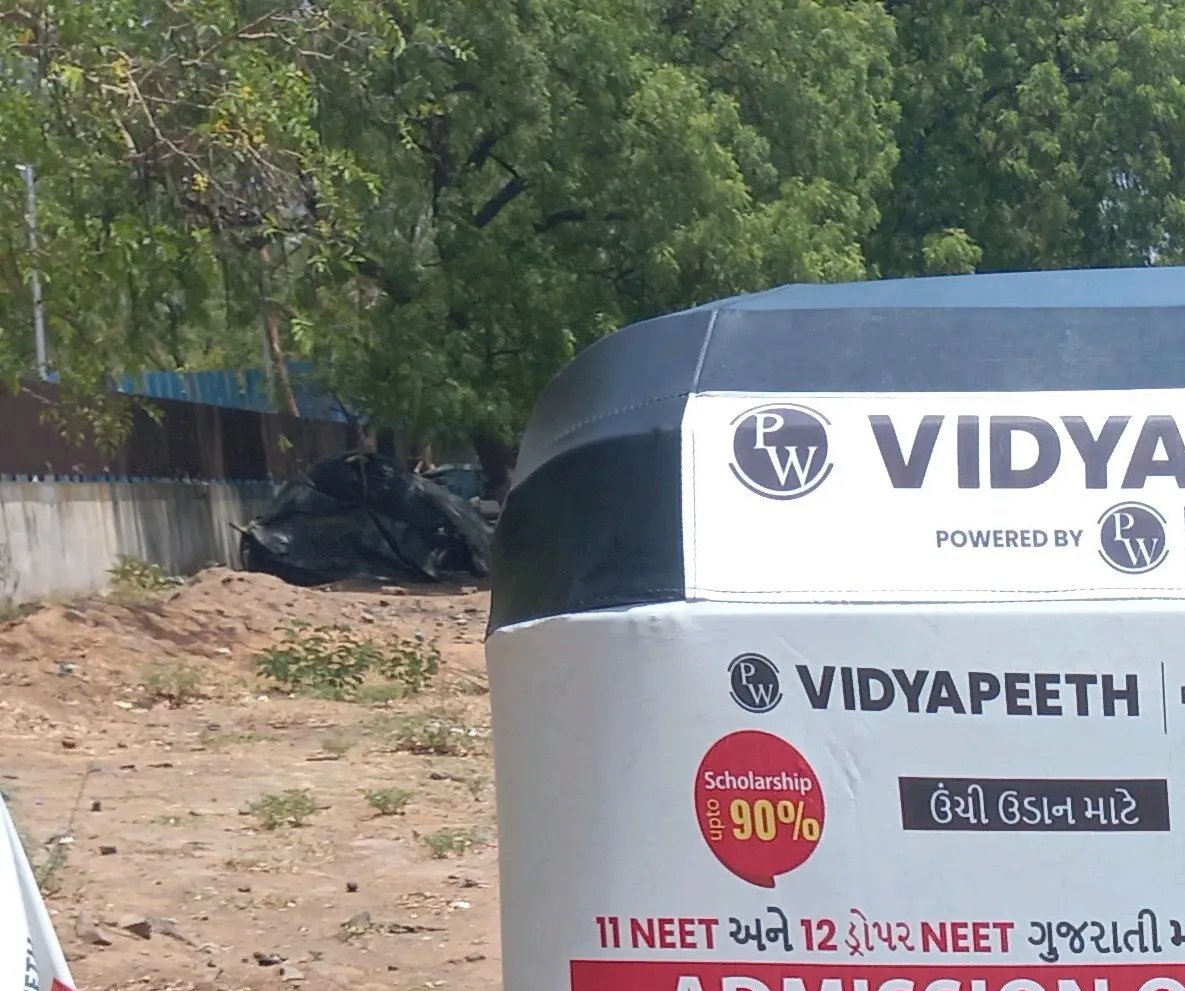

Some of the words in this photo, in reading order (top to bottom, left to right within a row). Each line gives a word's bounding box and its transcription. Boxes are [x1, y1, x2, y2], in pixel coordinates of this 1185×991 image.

[935, 527, 1048, 551] POWERED
[1053, 527, 1084, 549] BY
[795, 664, 1140, 717] VIDYAPEETH
[704, 770, 813, 796] Scholarship
[929, 783, 989, 825] ઉંચી
[998, 790, 1076, 825] ઉડાન
[1083, 788, 1140, 825] માટે
[706, 799, 725, 841] upto
[730, 798, 820, 841] 90%
[596, 916, 620, 948] 11
[631, 917, 719, 950] NEET
[728, 906, 794, 952] અને
[800, 919, 837, 952] 12
[844, 908, 916, 957] ડ્રોપર
[922, 921, 1014, 953] NEET
[1027, 908, 1161, 963] ગુજરાતી
